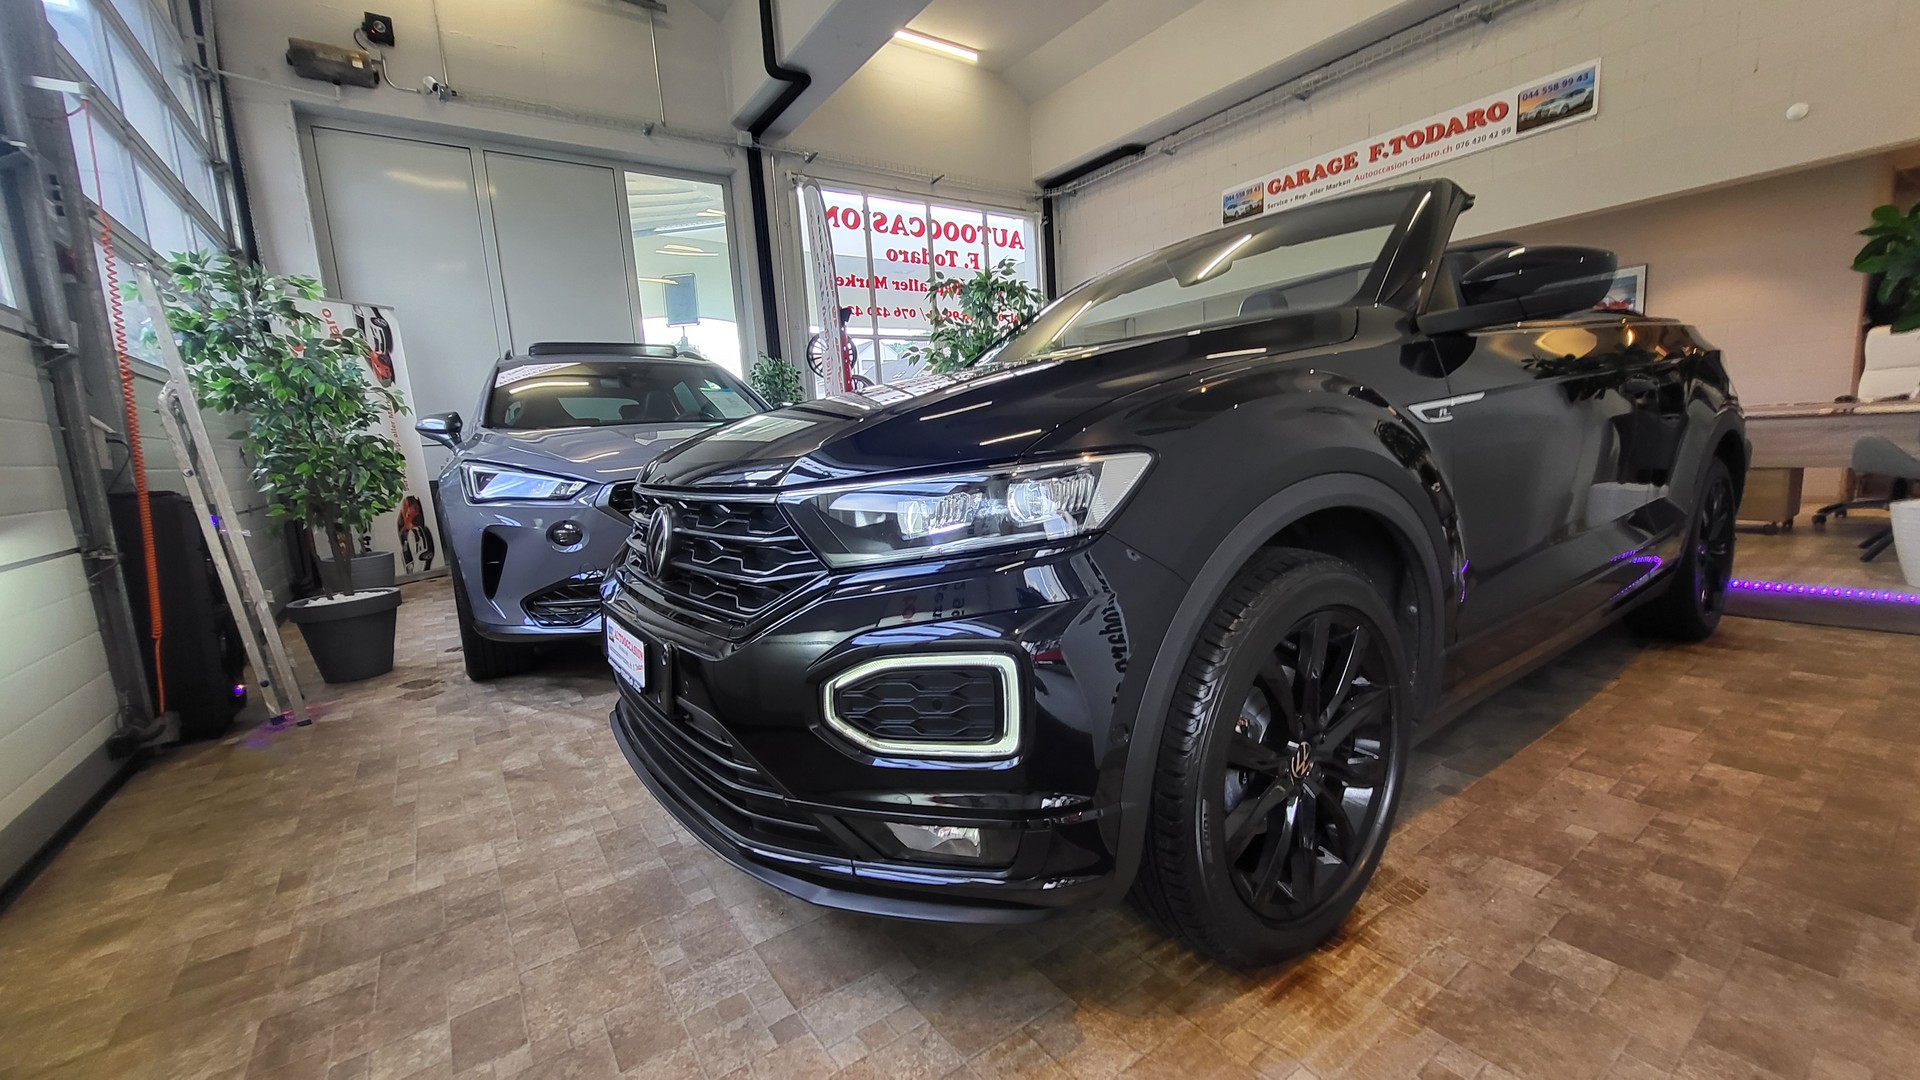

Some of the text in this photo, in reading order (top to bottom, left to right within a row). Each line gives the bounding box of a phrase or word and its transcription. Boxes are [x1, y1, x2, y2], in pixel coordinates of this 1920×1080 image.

[1522, 72, 1589, 101] 044 558 99 43
[1267, 198, 1288, 210] Service
[1294, 192, 1308, 202] Rep.
[1309, 187, 1324, 196] aller
[1325, 178, 1351, 191] Marken
[1354, 145, 1453, 183] Autooccasion-todaro.ch
[1455, 139, 1470, 150] 076
[1472, 135, 1487, 145] 420
[1489, 130, 1499, 141] 42
[1501, 126, 1512, 136] 99
[1267, 151, 1358, 195] GARAGE
